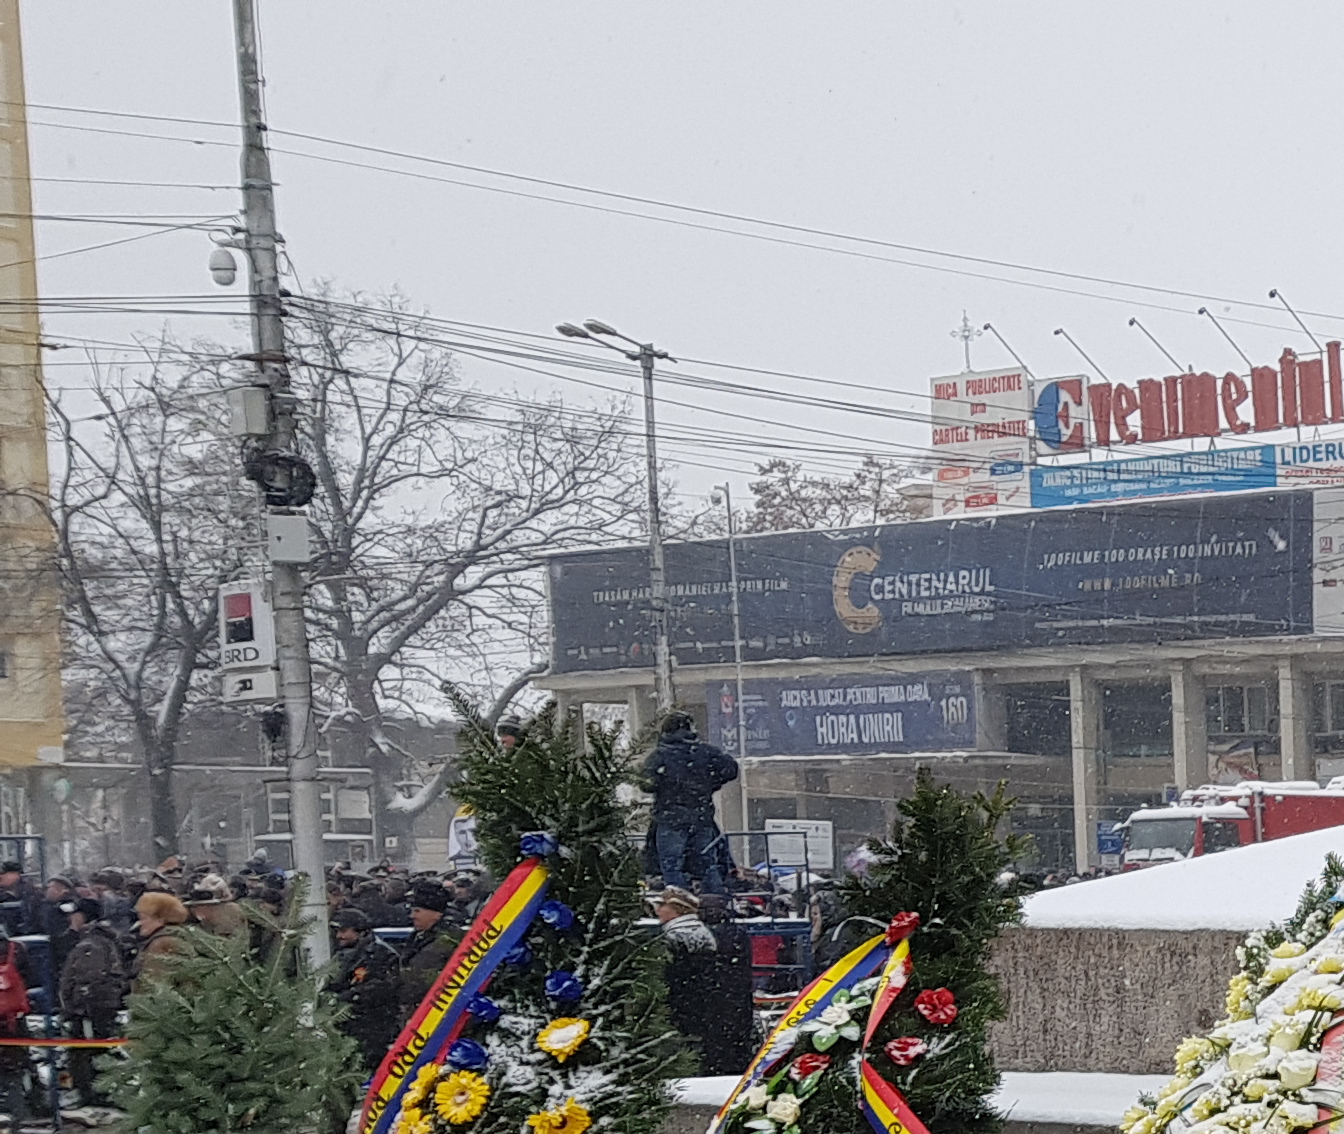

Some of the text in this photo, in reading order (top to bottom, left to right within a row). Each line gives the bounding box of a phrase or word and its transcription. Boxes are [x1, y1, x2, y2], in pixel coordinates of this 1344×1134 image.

[966, 374, 1023, 396] PUBLICITATE
[933, 425, 970, 445] CARTELE
[870, 567, 995, 601] CENTENARUL
[940, 696, 968, 726] 160
[815, 711, 856, 745] HORA
[388, 1028, 431, 1080] PRO
